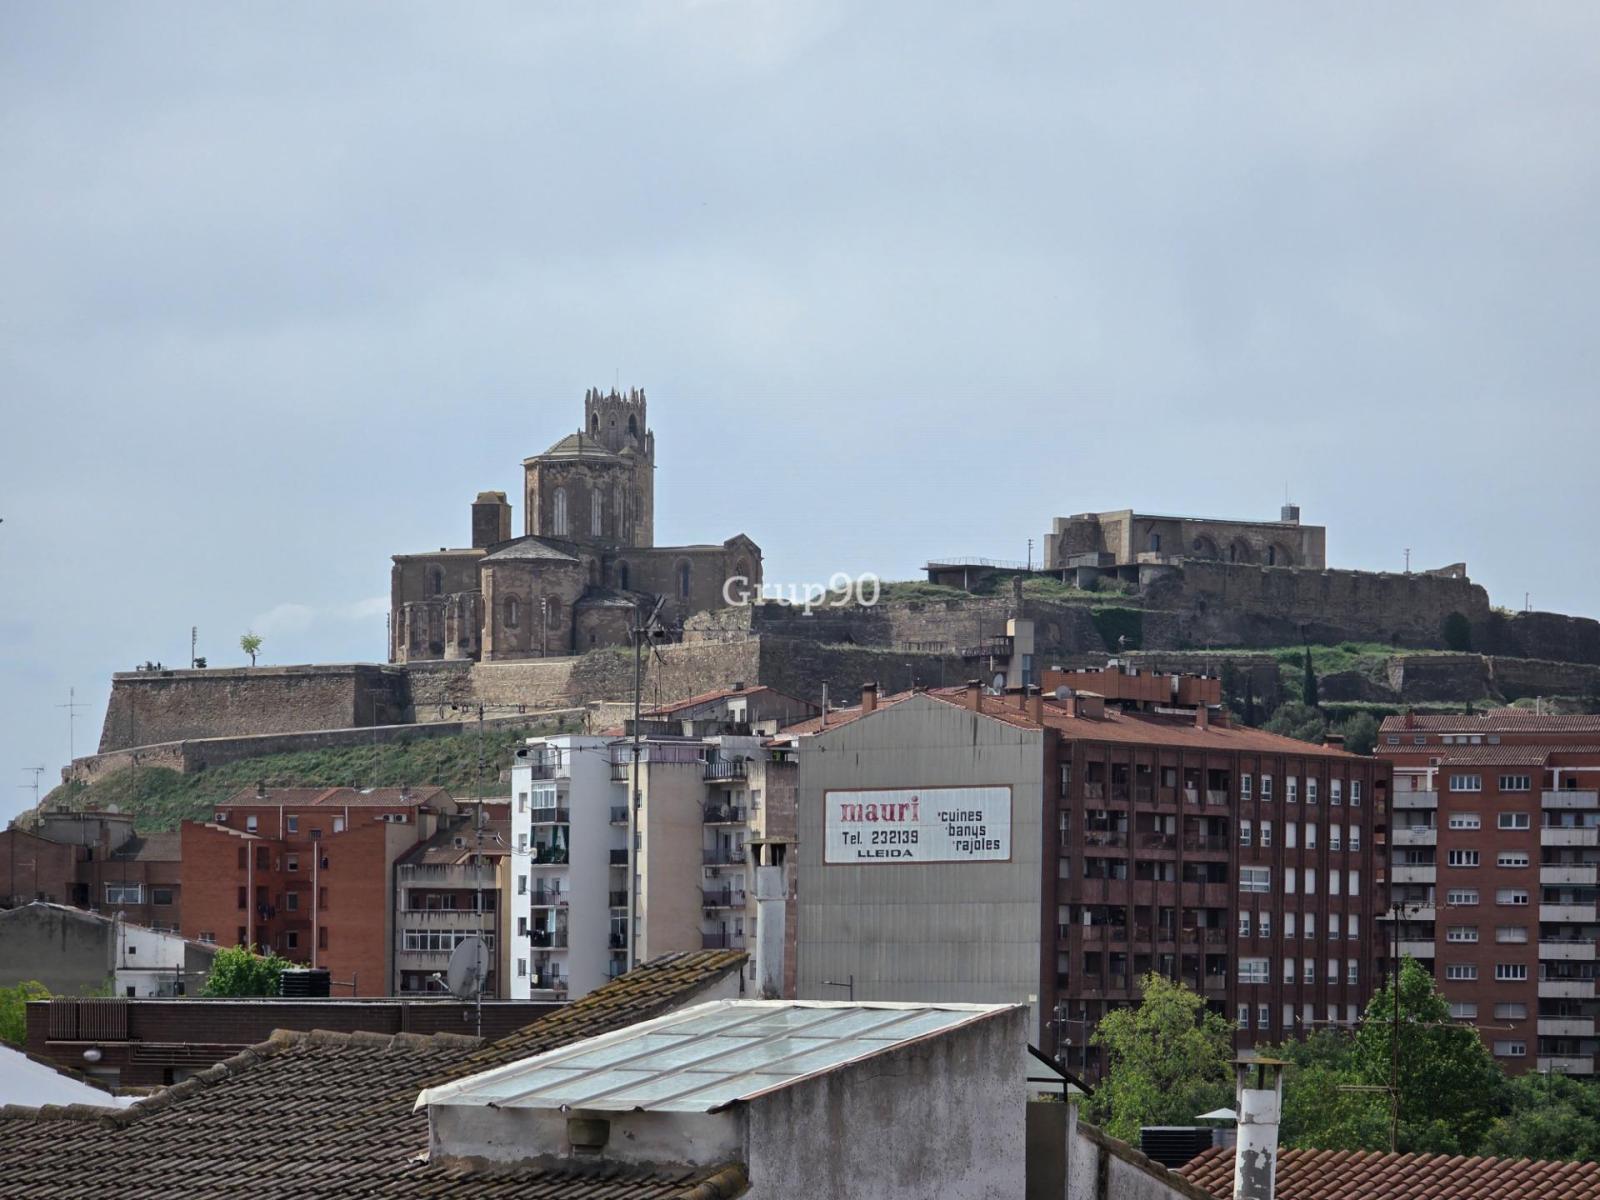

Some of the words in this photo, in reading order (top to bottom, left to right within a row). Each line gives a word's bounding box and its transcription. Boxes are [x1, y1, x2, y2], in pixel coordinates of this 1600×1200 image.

[840, 795, 919, 822] mauri
[941, 809, 982, 822] cuines
[842, 831, 863, 846] Tel.
[871, 830, 919, 845] 232139
[948, 823, 987, 839] banys
[857, 849, 914, 858] LLEIDA
[955, 838, 1000, 854] rajoles
